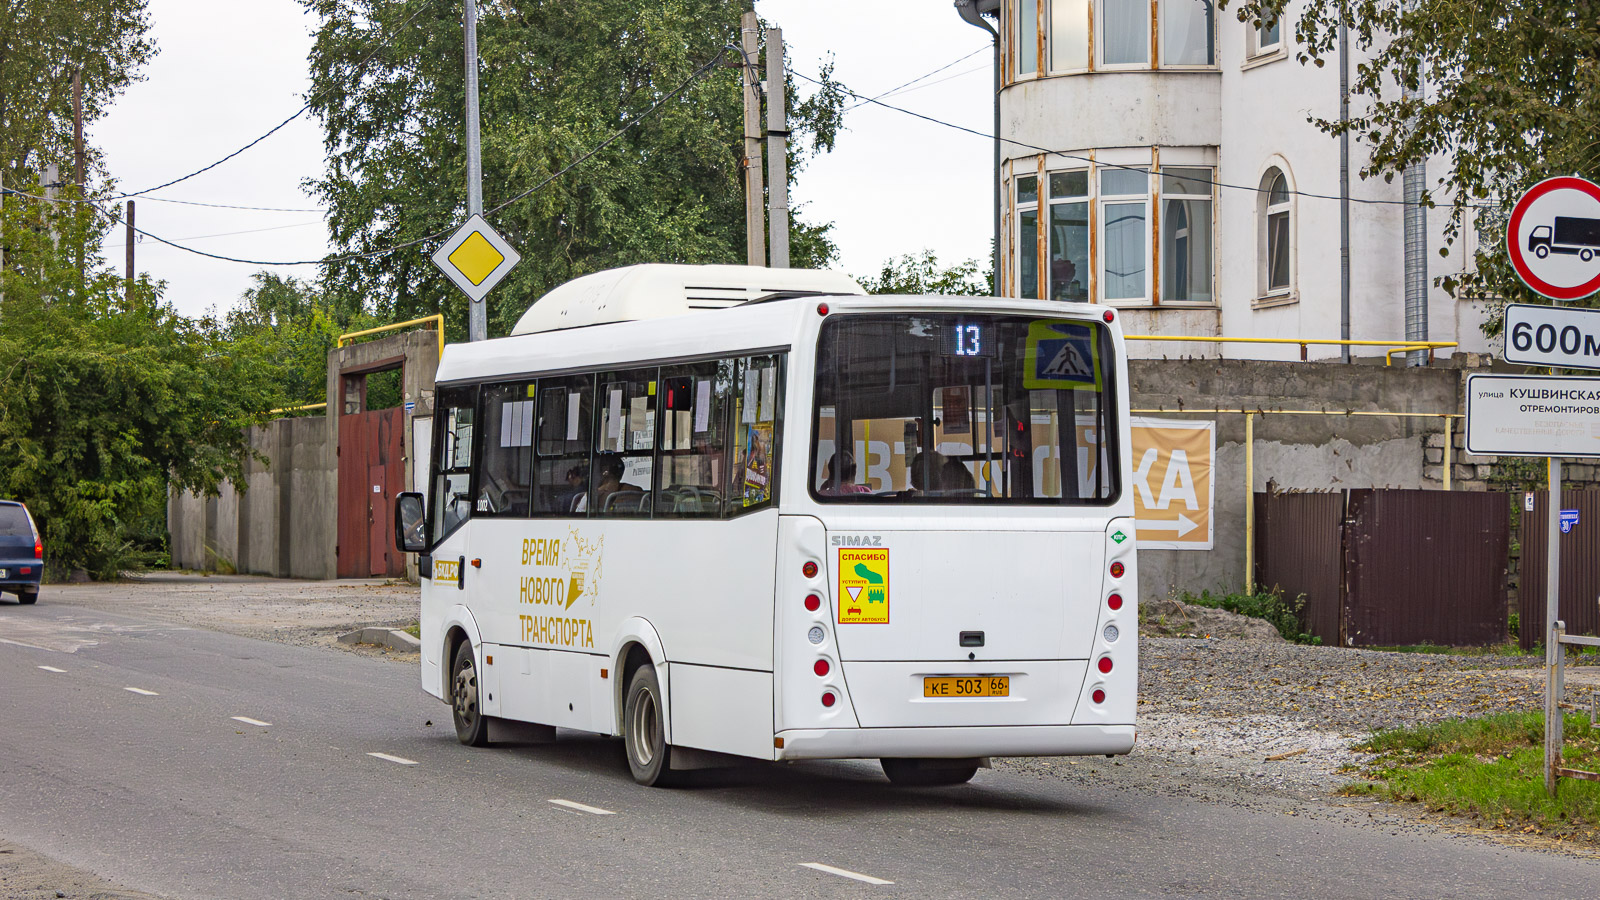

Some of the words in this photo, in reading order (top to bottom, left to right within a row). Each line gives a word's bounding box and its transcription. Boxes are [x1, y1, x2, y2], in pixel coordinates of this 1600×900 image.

[956, 325, 980, 356] 13
[1478, 391, 1504, 399] улица
[831, 535, 882, 546] SIMAZ
[521, 538, 560, 567] ВРЕМЯ
[842, 553, 886, 561] СПАСИБО
[519, 576, 564, 606] НОВОГО
[519, 614, 594, 649] ТРАНСПОРТА
[956, 679, 982, 694] 503
[990, 679, 1004, 690] 66
